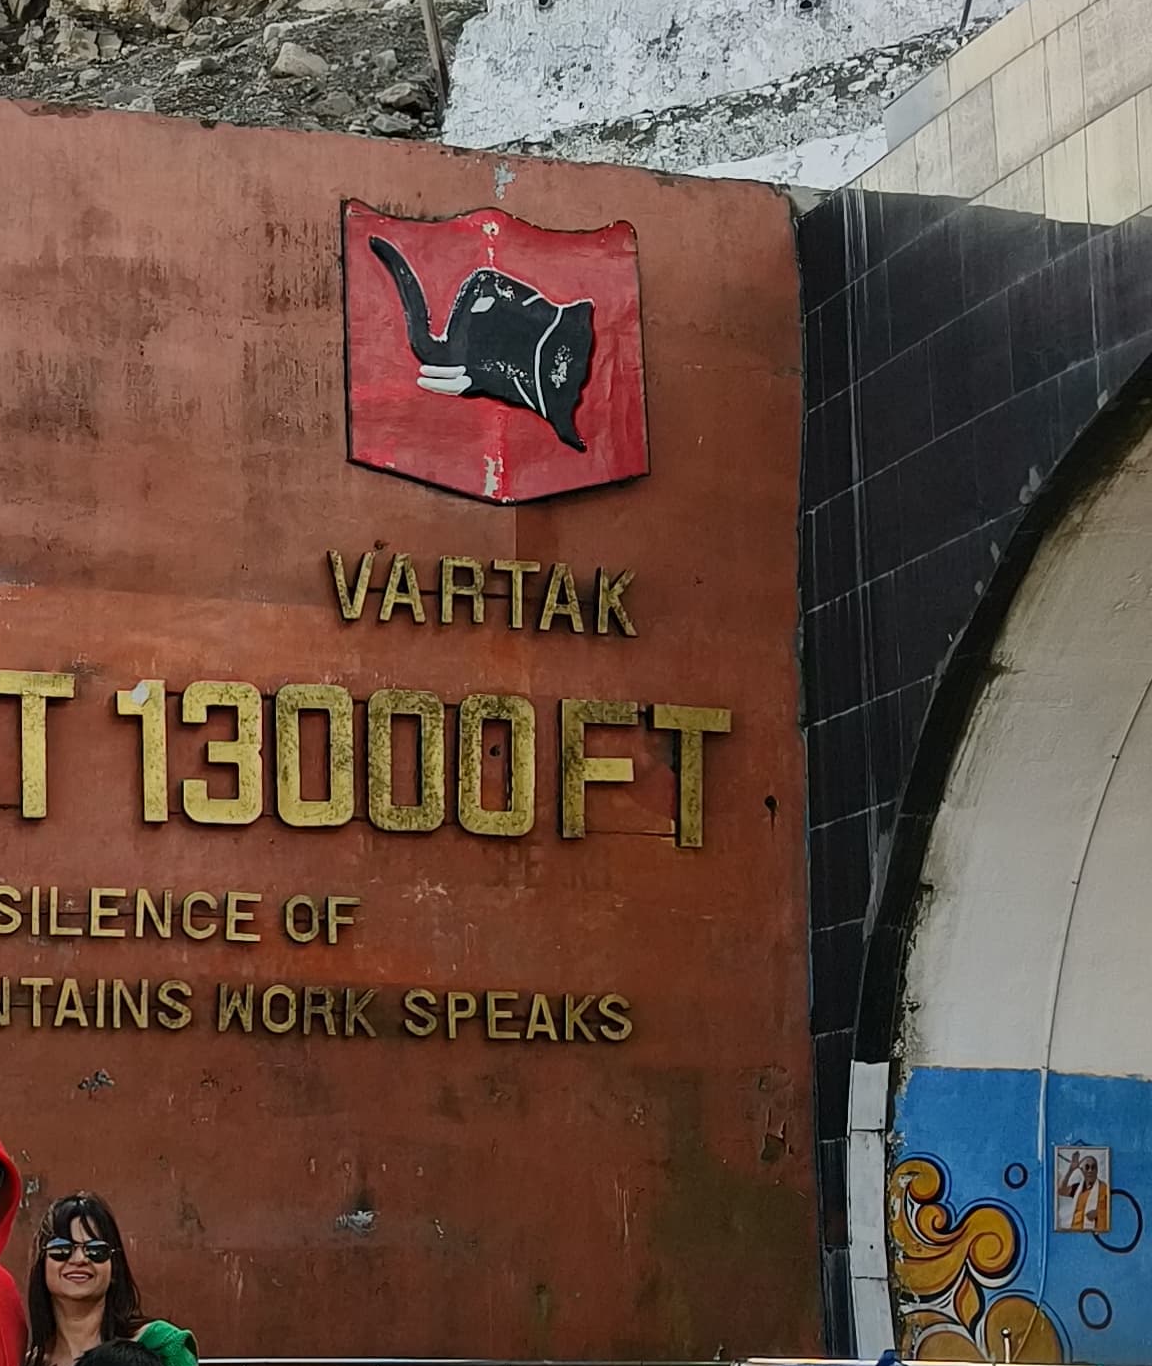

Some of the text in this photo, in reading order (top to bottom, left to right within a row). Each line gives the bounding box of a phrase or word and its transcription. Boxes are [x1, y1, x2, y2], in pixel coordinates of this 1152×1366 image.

[327, 549, 639, 637] VARTAK
[284, 894, 362, 946] OF
[216, 983, 378, 1037] WORK
[403, 988, 635, 1043] SPEAKS
